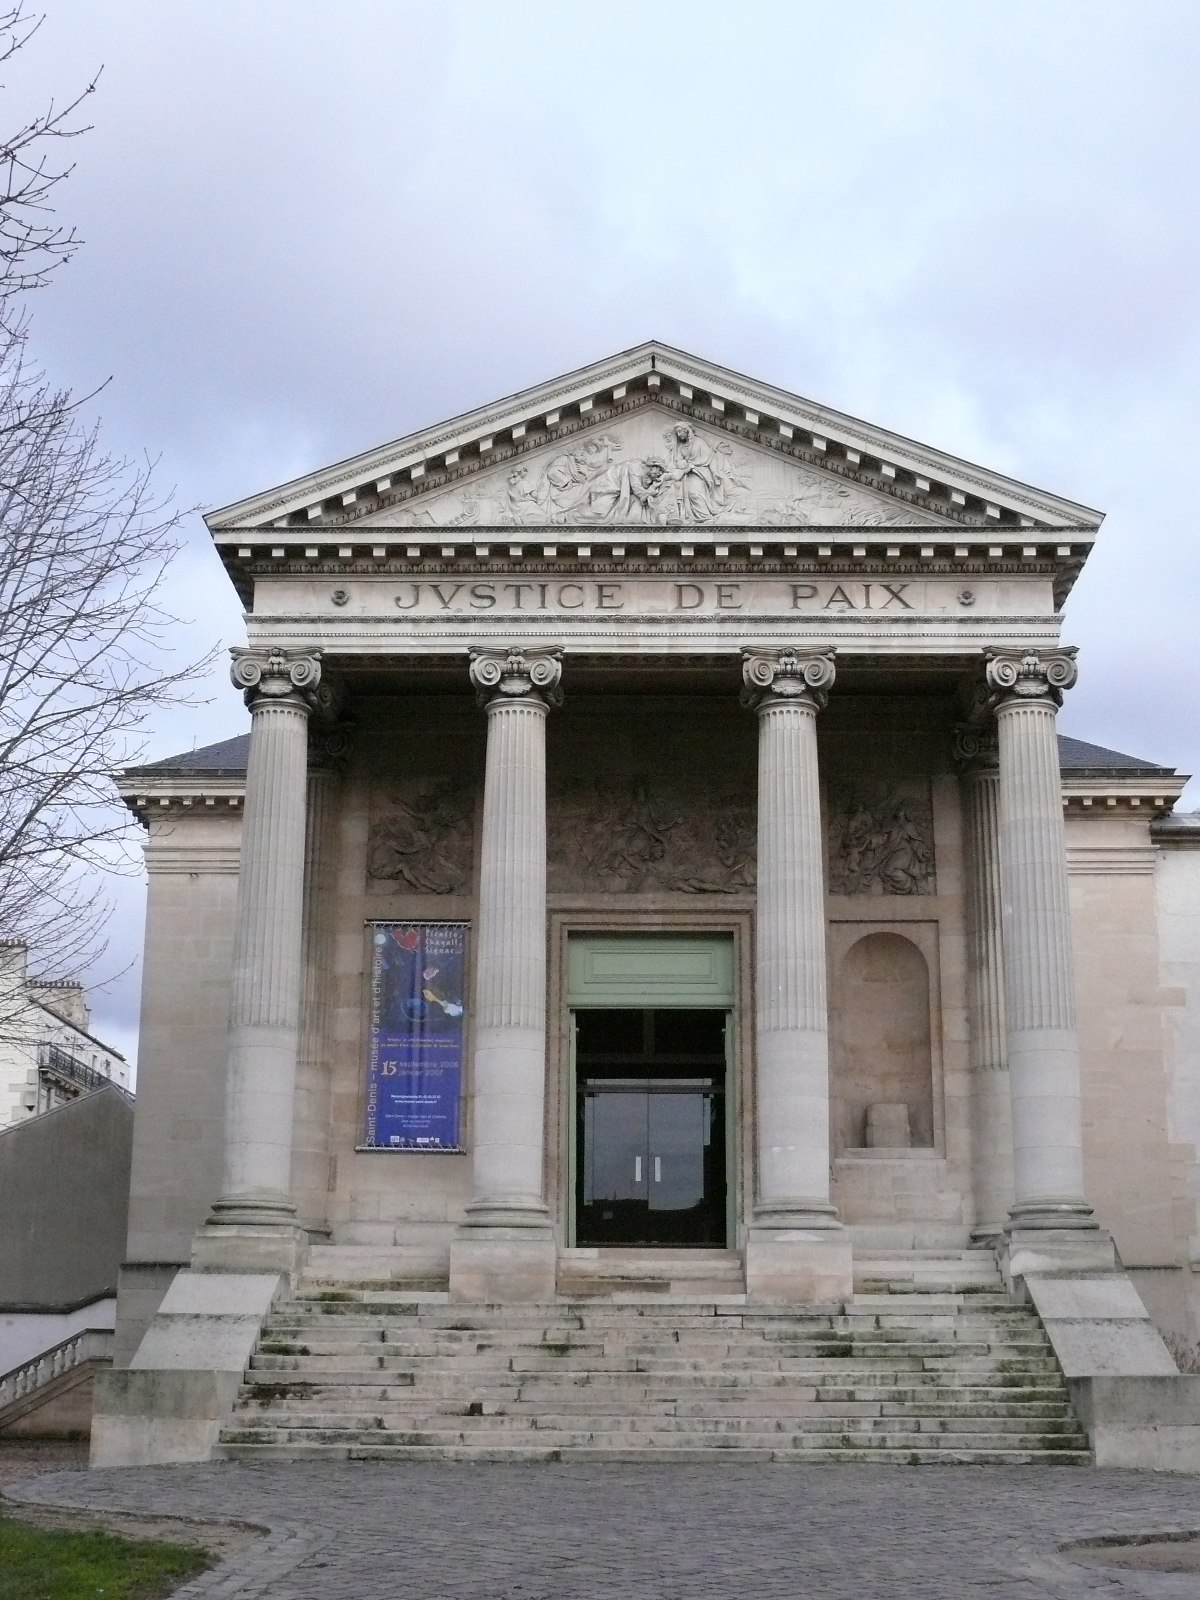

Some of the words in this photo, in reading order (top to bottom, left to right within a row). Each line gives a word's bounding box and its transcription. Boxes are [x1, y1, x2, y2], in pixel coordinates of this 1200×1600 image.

[394, 583, 624, 610] JVSTICE
[674, 584, 742, 609] DE
[789, 584, 916, 610] PAIX
[373, 995, 381, 1007] et
[369, 1037, 380, 1070] musée
[380, 1060, 397, 1076] 15
[399, 1061, 438, 1070] septembre
[398, 1069, 423, 1077] janvier
[424, 1069, 444, 1077] 2007
[366, 1083, 378, 1143] Saint-Denis
